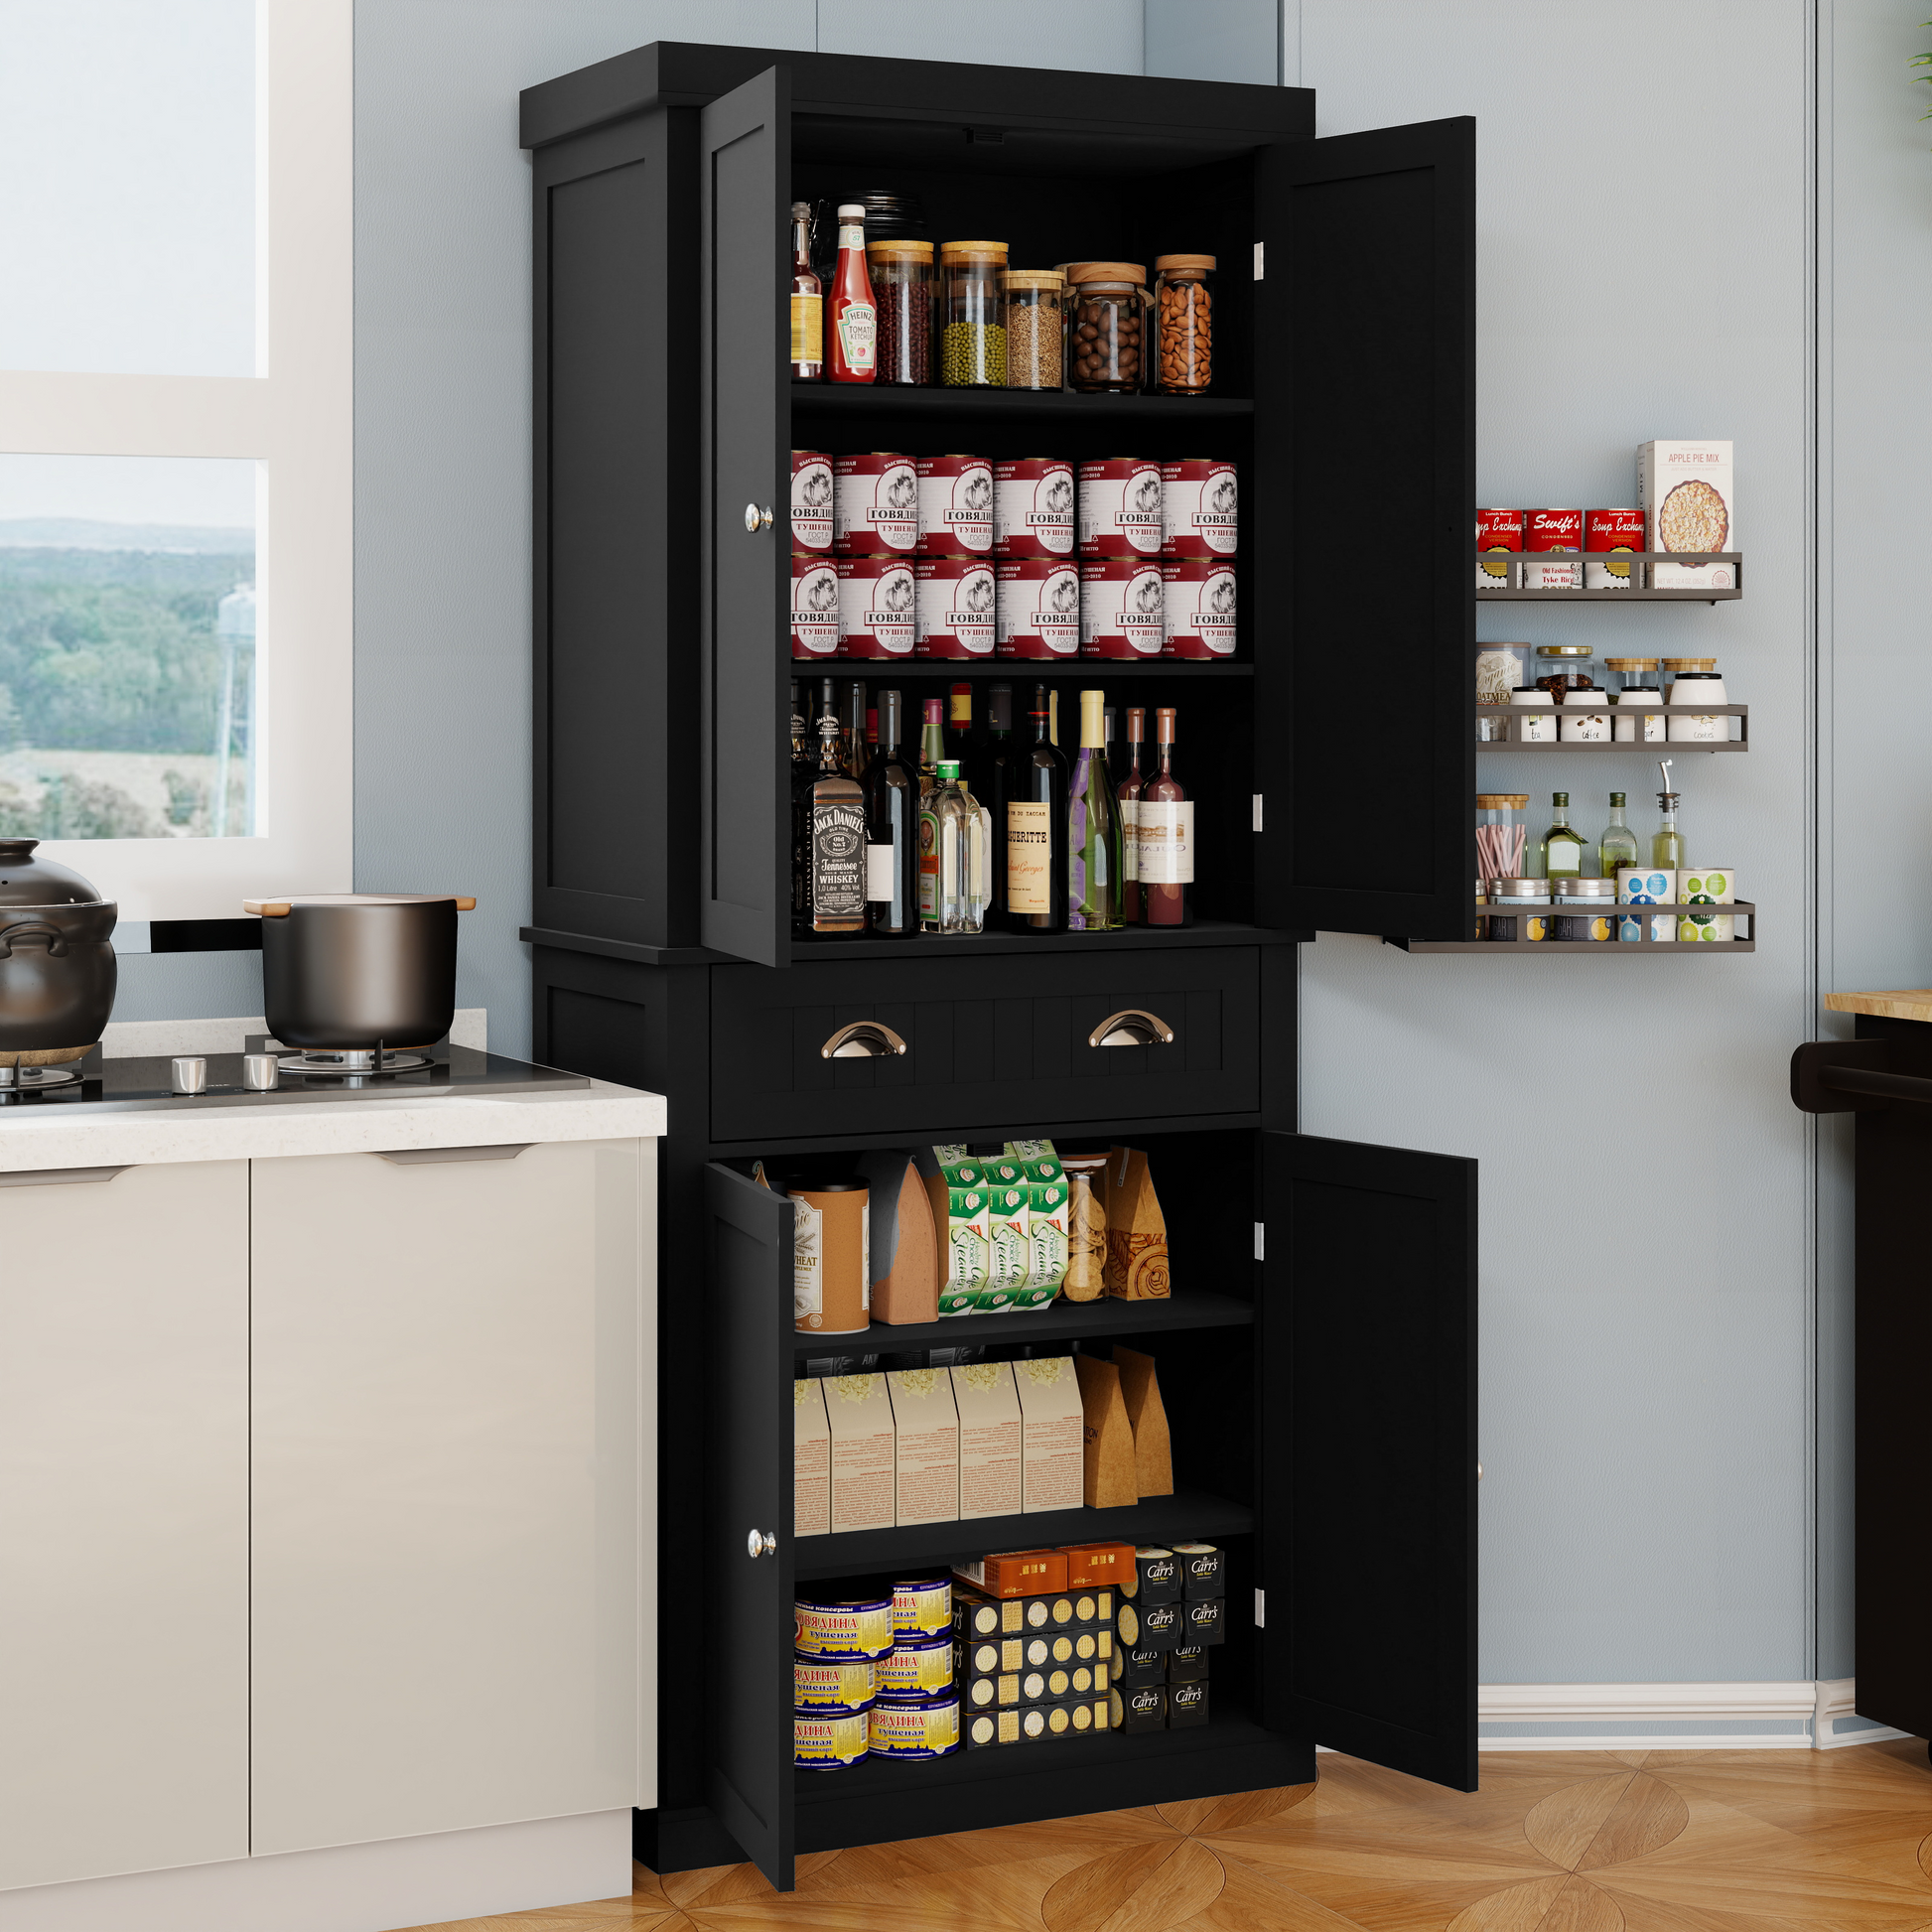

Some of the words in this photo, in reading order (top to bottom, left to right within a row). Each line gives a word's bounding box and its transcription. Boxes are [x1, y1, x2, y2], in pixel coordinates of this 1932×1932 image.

[850, 311, 873, 321] HEINZ
[1669, 453, 1691, 463] APPLE
[1693, 453, 1705, 463] PIE
[1706, 453, 1720, 463] MIX
[792, 508, 833, 519] ОВЯДИН
[1533, 513, 1580, 534] Swift's
[1592, 517, 1612, 536] Soup
[1476, 661, 1516, 691] Organic
[1531, 729, 1541, 740] tea
[1582, 730, 1599, 740] coffee
[1645, 730, 1654, 741] gar
[814, 813, 833, 835] JACK
[834, 809, 865, 833] DANIEL'S
[1008, 830, 1047, 843] GUERITTE
[821, 859, 857, 871] Tennessee
[819, 875, 859, 884] WHISKEY
[794, 1256, 818, 1267] HEAT
[950, 1228, 970, 1292] Steamers
[991, 1226, 1010, 1289] Steamers
[1031, 1223, 1049, 1286] Steamers
[1147, 1563, 1174, 1579] Carr's
[1191, 1558, 1218, 1574] Carr's
[1147, 1610, 1174, 1626] Carr's
[1191, 1605, 1218, 1621] Carr's
[794, 1670, 841, 1683] ЯДИНА
[1132, 1693, 1159, 1709] Carr's
[1175, 1688, 1202, 1704] Carr's
[869, 1712, 926, 1727] ОВЯДИНА
[794, 1725, 834, 1738] ДИНА
